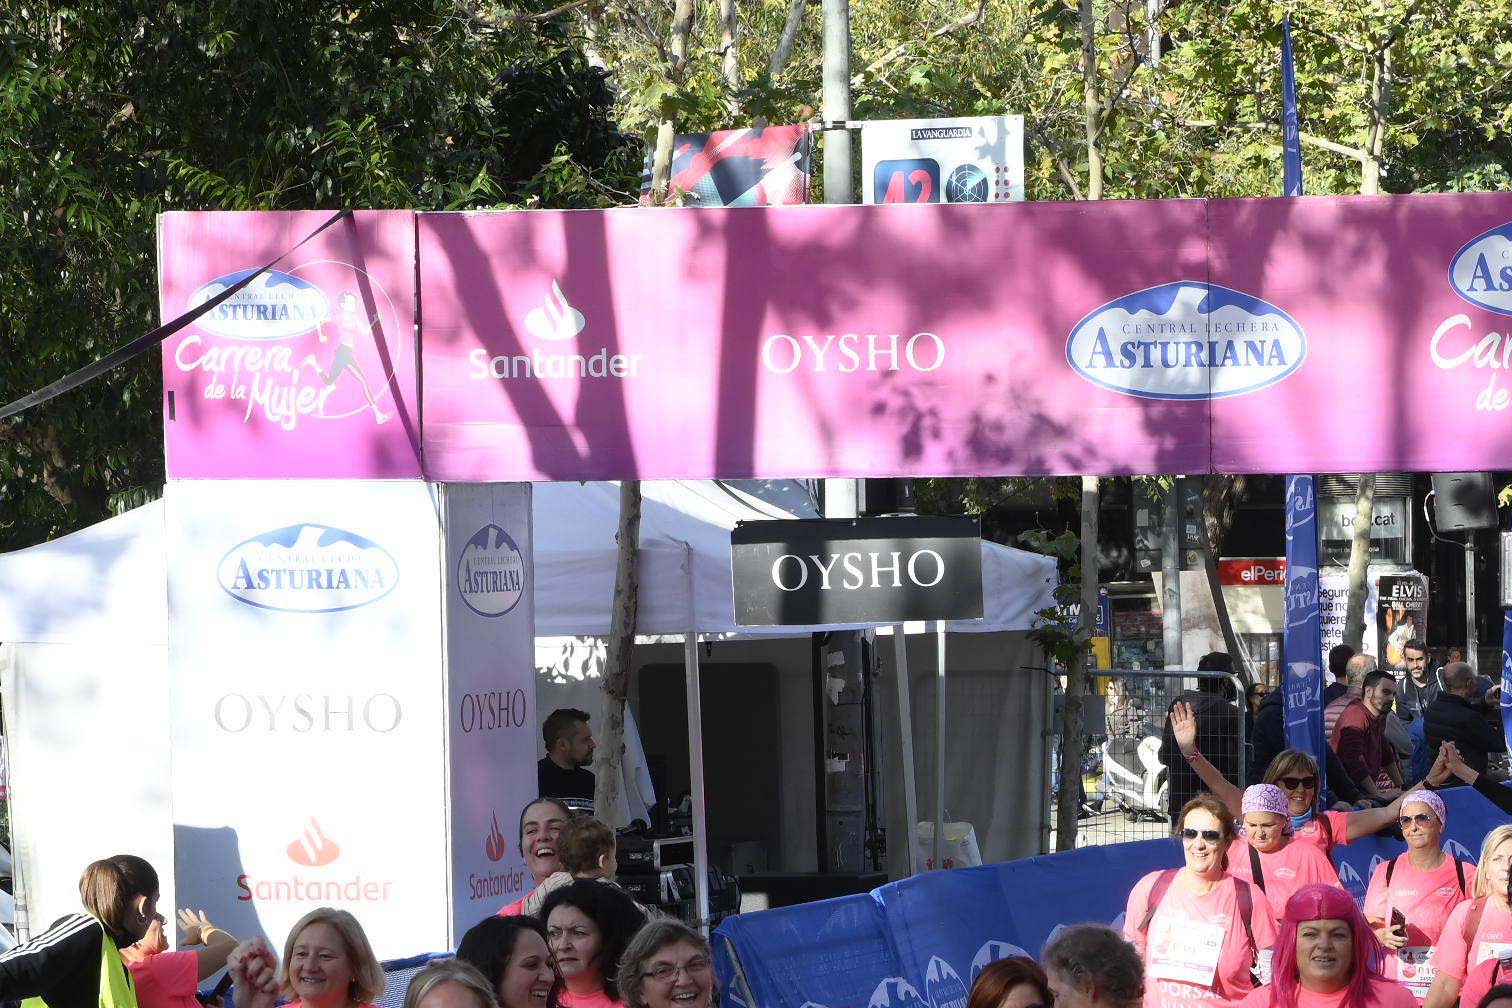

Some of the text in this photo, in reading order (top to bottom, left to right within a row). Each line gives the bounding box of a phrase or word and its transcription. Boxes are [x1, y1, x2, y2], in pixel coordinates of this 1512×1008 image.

[921, 128, 971, 138] VANGUARDIA
[1122, 321, 1280, 335] CENTRAL LECHERA
[175, 335, 293, 372] Carrera
[468, 347, 644, 380] Santander
[762, 332, 945, 374] OYSHO
[1085, 326, 1287, 370] ASTURIANA
[204, 376, 247, 400] de la
[243, 370, 336, 431] Mujer
[1475, 373, 1509, 412] de
[1342, 512, 1395, 526] b.cat
[232, 557, 386, 591] ASTURIANA
[463, 567, 521, 594] ASTURIANA
[772, 549, 946, 592] OYSHO
[1392, 585, 1423, 597] ELVIS
[214, 692, 403, 733] OYSHO
[461, 689, 526, 733] OYSHO
[237, 873, 395, 902] Santander
[469, 869, 524, 901] Santander
